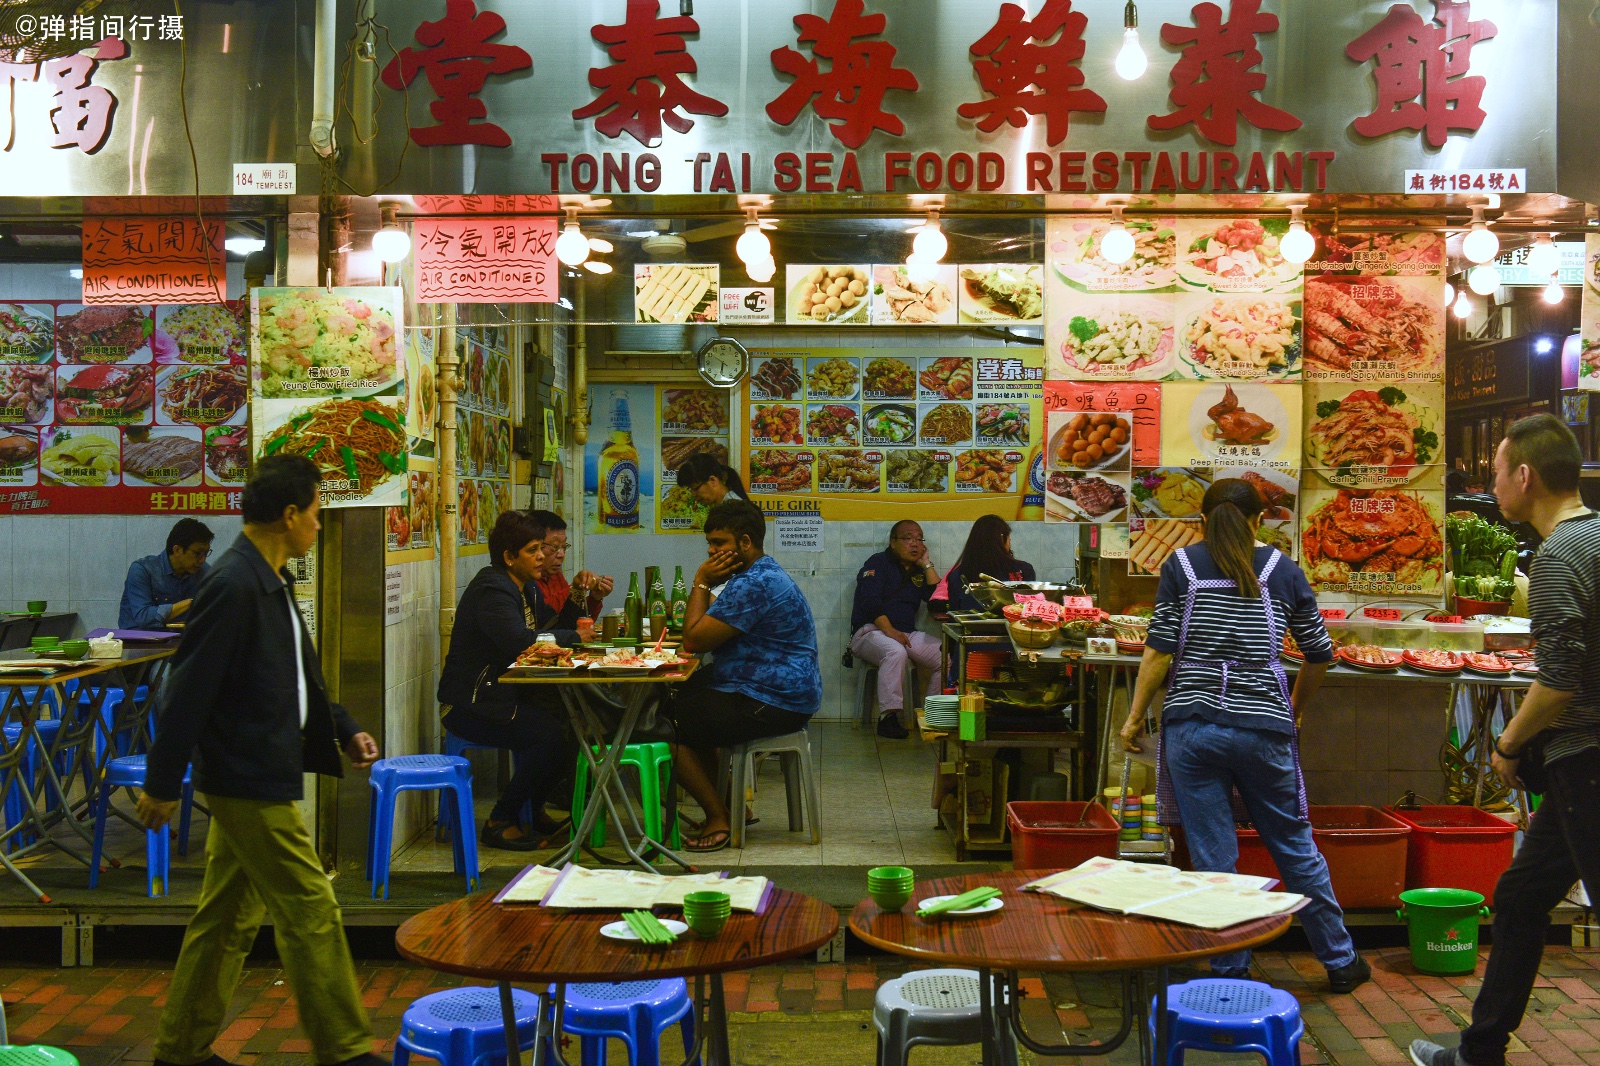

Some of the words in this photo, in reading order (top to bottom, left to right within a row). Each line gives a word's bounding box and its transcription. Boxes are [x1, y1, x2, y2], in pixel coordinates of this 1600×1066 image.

[381, 0, 1498, 149] 堂泰海鮮菜館
[542, 153, 662, 193] TONG
[685, 153, 750, 193] TAI
[774, 152, 863, 192] SEA
[885, 152, 1005, 192] FOOD
[1026, 151, 1336, 192] RESTAURANT
[236, 173, 253, 185] 184
[85, 222, 220, 254] 冷氣開放
[420, 226, 555, 257] 冷氣開放
[1305, 261, 1319, 270] ried
[1321, 262, 1343, 270] Crabs
[1345, 262, 1354, 270] w/
[1356, 262, 1382, 272] Ginger
[1383, 262, 1389, 270] &
[1392, 262, 1415, 272] Spring
[1418, 262, 1441, 270] Onion
[85, 275, 110, 292] AIR
[117, 274, 219, 290] CONDITIONED
[420, 272, 442, 285] AIR
[450, 271, 546, 284] CONDITIONED
[1352, 285, 1395, 299] 招牌菜
[1306, 371, 1327, 381] Deep
[1330, 371, 1351, 380] Fried
[1353, 371, 1376, 381] Spicy
[1378, 371, 1406, 380] Mantis
[1408, 371, 1441, 381] Shrimps
[282, 381, 308, 390] Yeung
[310, 380, 334, 389] Chow
[336, 380, 358, 388] Fried
[360, 379, 378, 388] Rice
[1191, 459, 1211, 467] Deep
[1238, 459, 1258, 467] Baby
[1261, 459, 1290, 467] Pigeon
[1330, 476, 1355, 484] Garlic
[1378, 476, 1409, 484] Prawns
[329, 493, 363, 501] Noodles
[788, 501, 820, 510] GIRL
[1351, 499, 1394, 514] 招牌菜
[1323, 583, 1345, 592] Deep
[1347, 583, 1370, 591] Fried
[1371, 583, 1395, 592] Spicy
[1397, 583, 1422, 591] Crabs
[1426, 941, 1473, 951] Heineken
